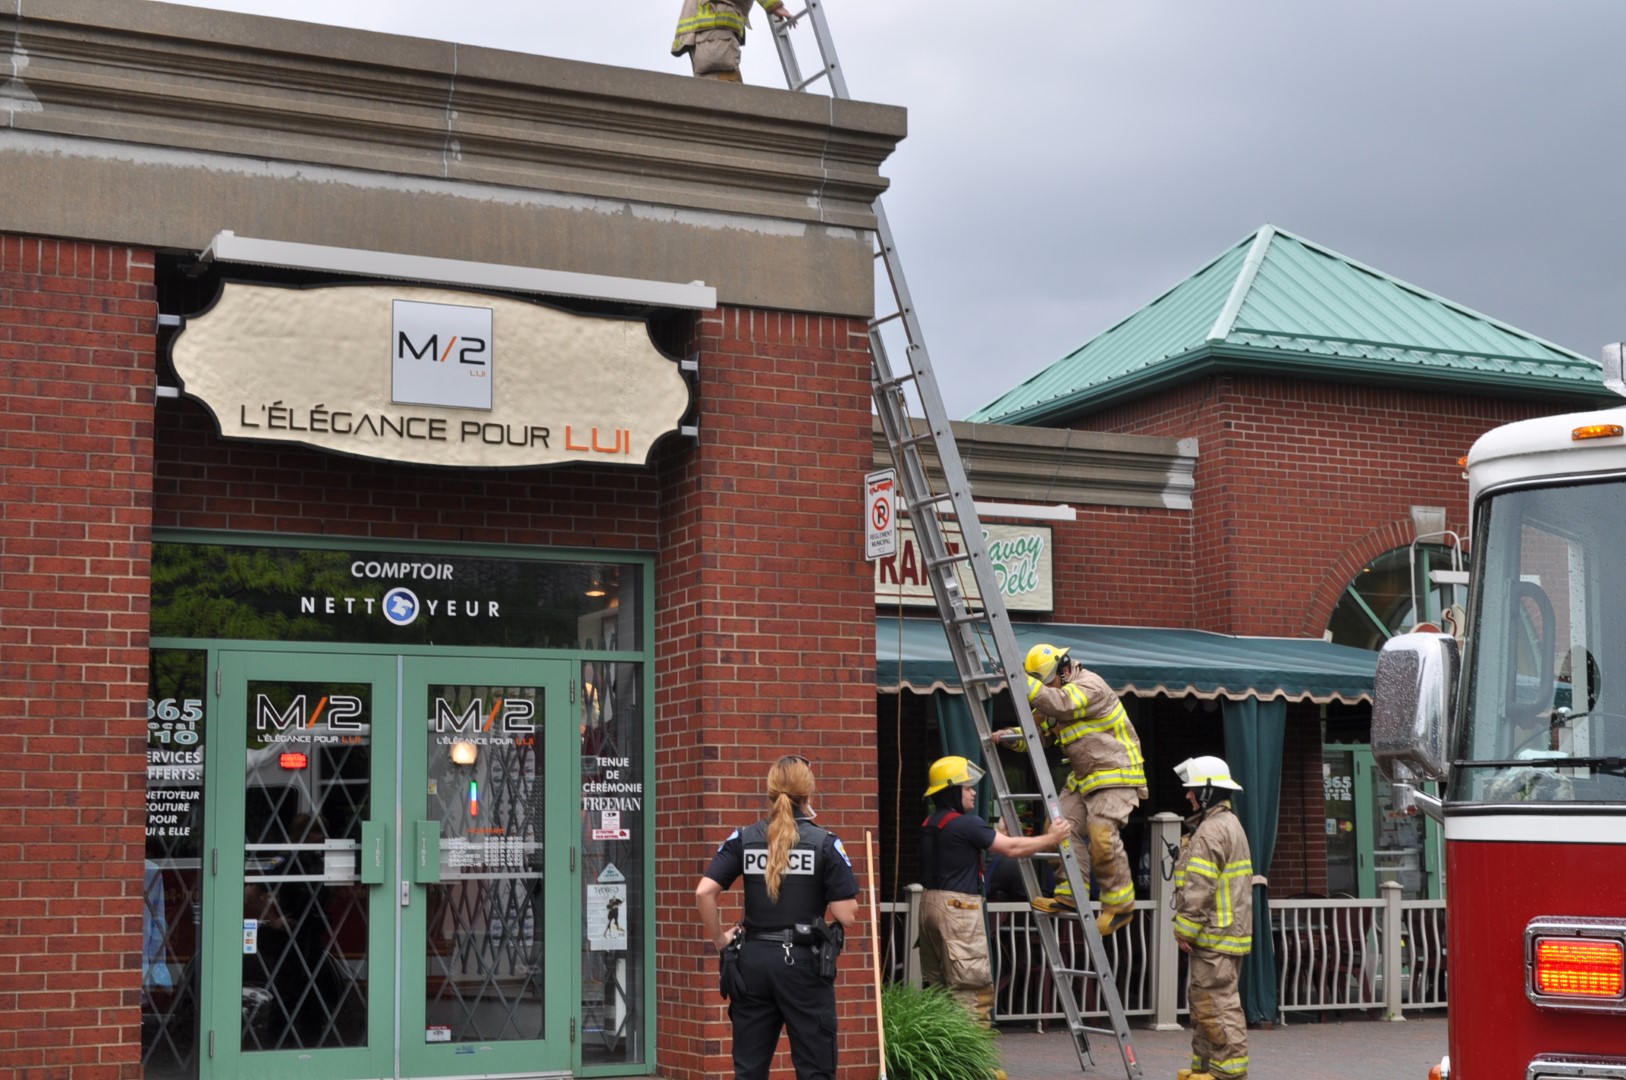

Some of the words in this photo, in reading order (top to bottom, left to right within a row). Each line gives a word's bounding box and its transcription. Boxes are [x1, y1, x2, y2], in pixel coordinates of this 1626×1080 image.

[399, 331, 486, 365] M/2
[241, 400, 447, 441] L'ÉLÉGANCE
[461, 421, 550, 448] POUR
[565, 425, 630, 454] LUI
[967, 531, 1042, 569] avoy
[351, 561, 454, 580] COMPTOIR
[257, 694, 362, 731] M/2
[436, 698, 535, 733] M/2
[148, 721, 195, 731] ocal
[148, 730, 198, 745] 10
[314, 735, 338, 743] POUR
[489, 737, 513, 745] POUR
[147, 751, 200, 763] ERVICES
[596, 757, 629, 767] TENUE
[148, 768, 200, 780] FFERTS:
[606, 770, 620, 780] DE
[582, 780, 642, 792] CÉRÉMONIE
[146, 803, 190, 812] OUTURE
[583, 797, 642, 811] FREEMAN
[150, 815, 178, 824] POUR
[146, 827, 156, 836] UI
[158, 827, 166, 836] &
[168, 827, 190, 836] ELLE
[745, 853, 812, 871] POCE
